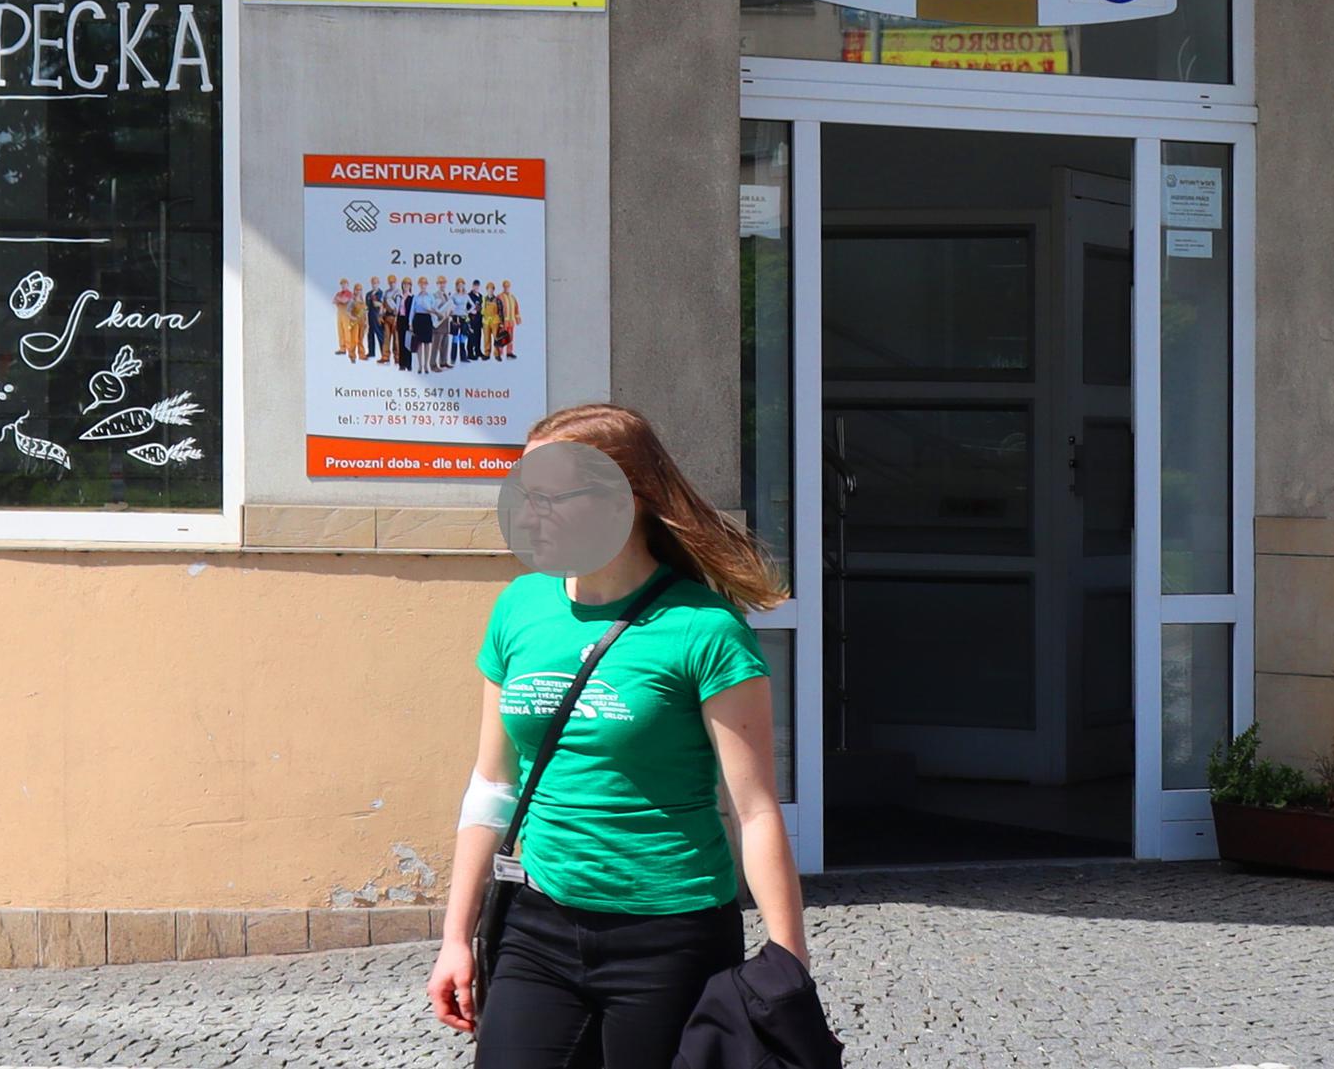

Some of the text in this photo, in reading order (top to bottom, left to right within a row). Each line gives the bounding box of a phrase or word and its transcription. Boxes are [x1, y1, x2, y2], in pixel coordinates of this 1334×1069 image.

[331, 162, 519, 182] AGENTURA PRÁCE
[389, 210, 507, 226] smartwork
[390, 249, 463, 268] 2. patro
[334, 387, 510, 400] Kamenice 155, 547 01 Náchod
[385, 401, 460, 412] IČ: 05270286
[338, 415, 507, 427] tel.: 737 851 793, 737 846 339
[325, 457, 384, 469] Provozní
[387, 458, 420, 469] doba
[432, 458, 452, 469] dle
[456, 459, 475, 470] tel.
